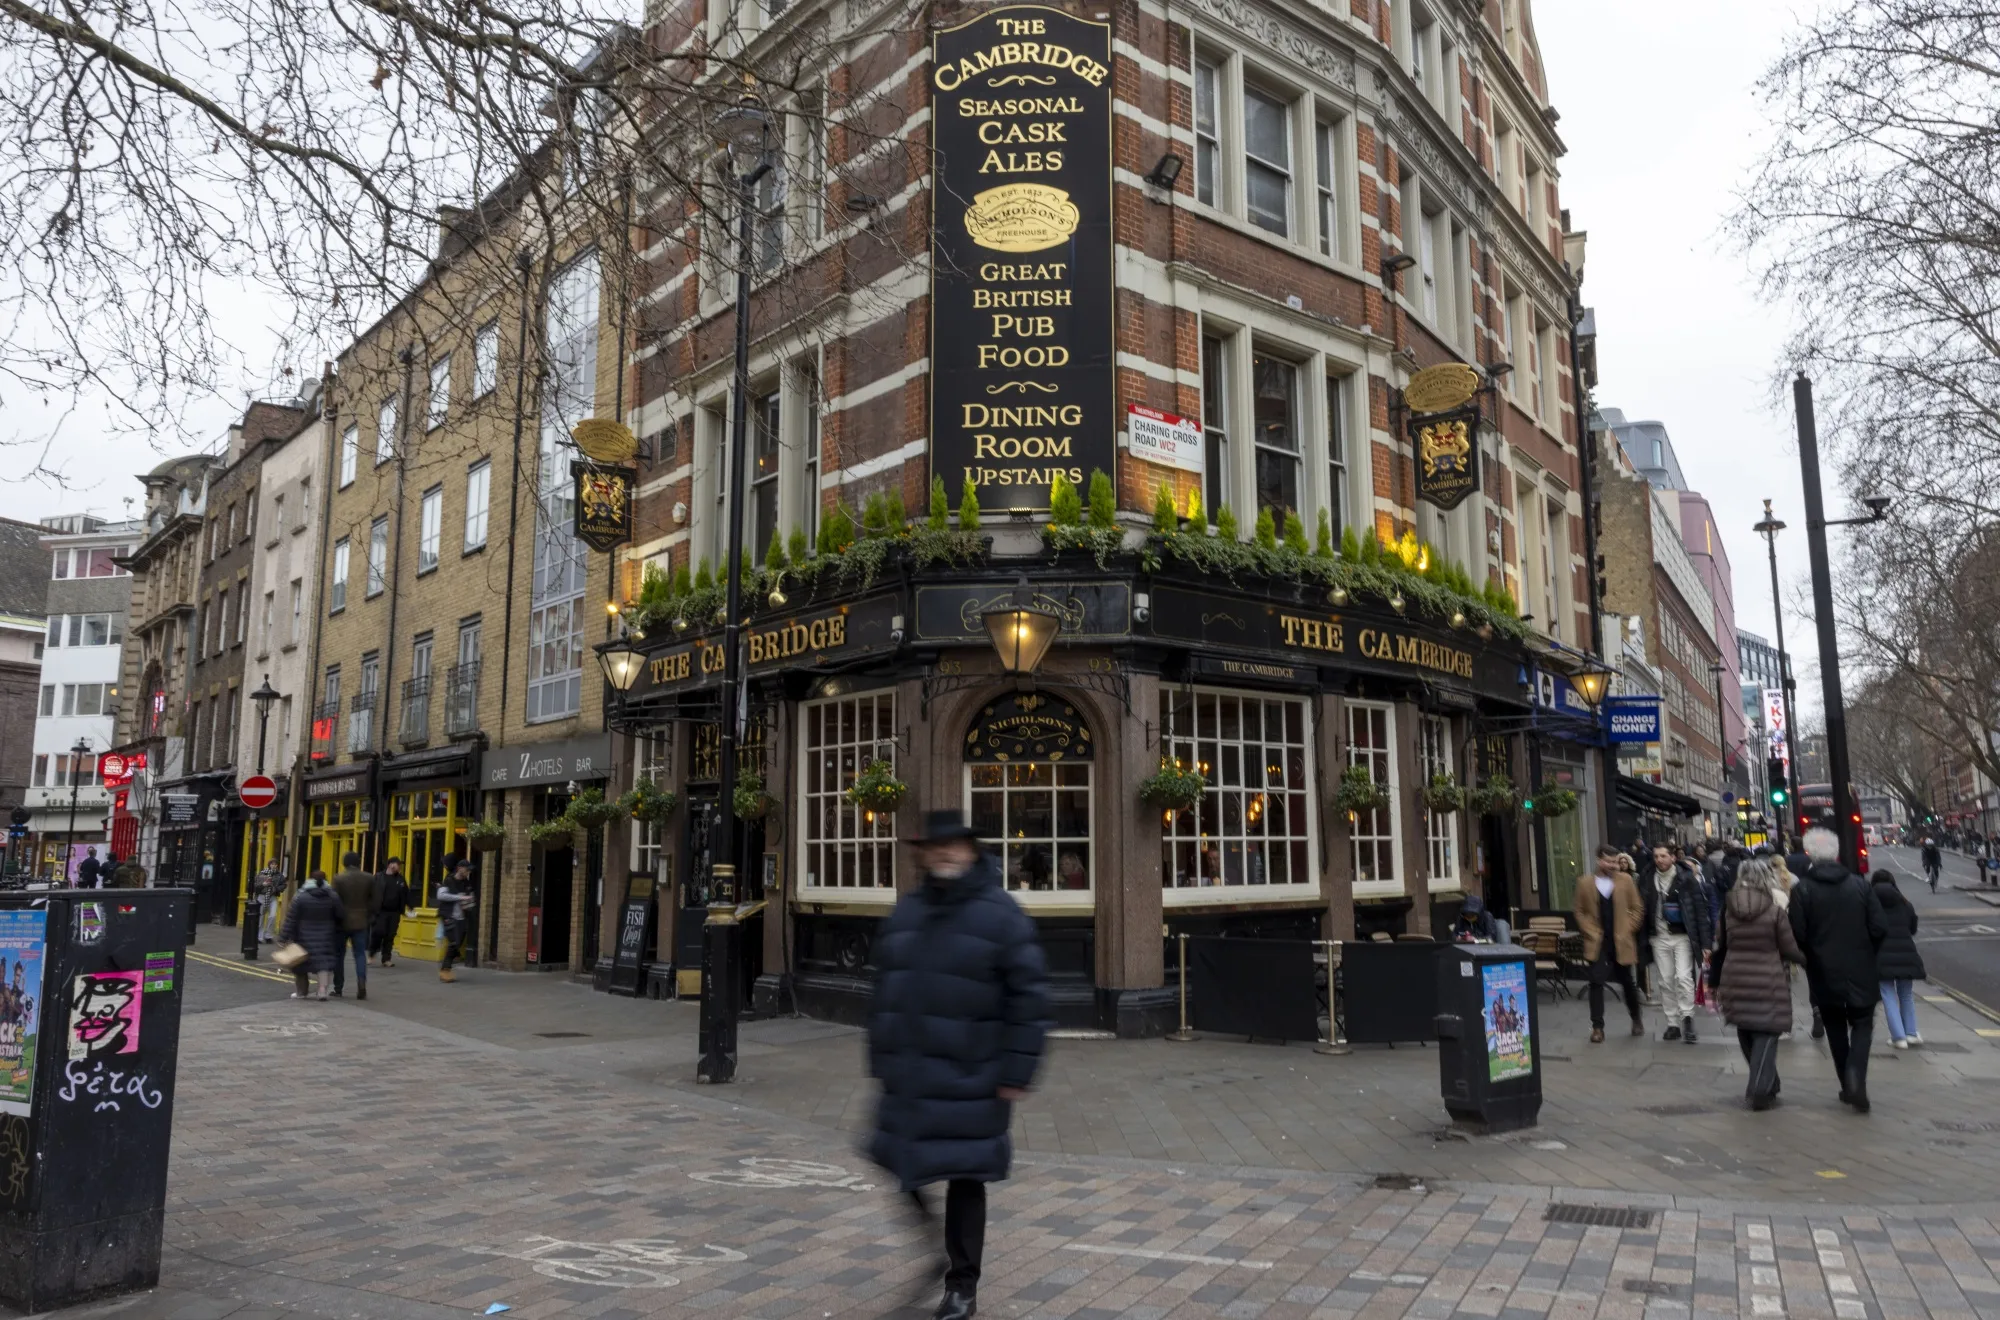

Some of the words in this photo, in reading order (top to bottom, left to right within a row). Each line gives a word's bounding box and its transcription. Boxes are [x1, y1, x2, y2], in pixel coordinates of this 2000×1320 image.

[996, 18, 1047, 36] THE
[934, 42, 1109, 91] CAMBRIDGE
[959, 97, 1084, 117] SEASONAL
[978, 121, 1067, 145] CASK
[978, 150, 1064, 173] ALES
[980, 206, 1066, 229] NICHOLSON'S
[997, 229, 1048, 237] FREEHOUSE
[980, 263, 1067, 282] GREAT
[973, 289, 1072, 309] BRITISH
[991, 314, 1055, 338] PUB
[977, 344, 1069, 369] FOOD
[961, 403, 1083, 429] DINING
[1134, 420, 1170, 438] CHARING
[1172, 430, 1198, 446] CROSS
[1135, 433, 1157, 447] ROAD
[1159, 439, 1176, 453] WC2
[973, 434, 1072, 459] ROOM
[963, 466, 1083, 486] UPSTAIRS
[1420, 477, 1474, 492] CAMBRIDGE
[1438, 472, 1455, 480] THE
[580, 522, 628, 536] CAMBRIDGE
[651, 651, 691, 685] THE
[701, 615, 846, 675] CABRIDGE
[1280, 614, 1344, 653] THE
[1358, 628, 1473, 679] CAMBRIDGE
[1088, 657, 1112, 672] 93
[1222, 660, 1241, 673] THE
[1242, 663, 1295, 679] CAMBRIDGE
[1611, 715, 1656, 724] CHANGE
[1611, 723, 1656, 733] MONEY
[492, 768, 508, 782] CAFE
[519, 752, 531, 779] Z
[530, 757, 563, 778] HOTELS
[575, 757, 592, 772] BAR
[626, 910, 645, 926] FISH
[0, 1022, 17, 1043] CK
[1495, 1030, 1517, 1047] JACK
[0, 1044, 23, 1057] STALK
